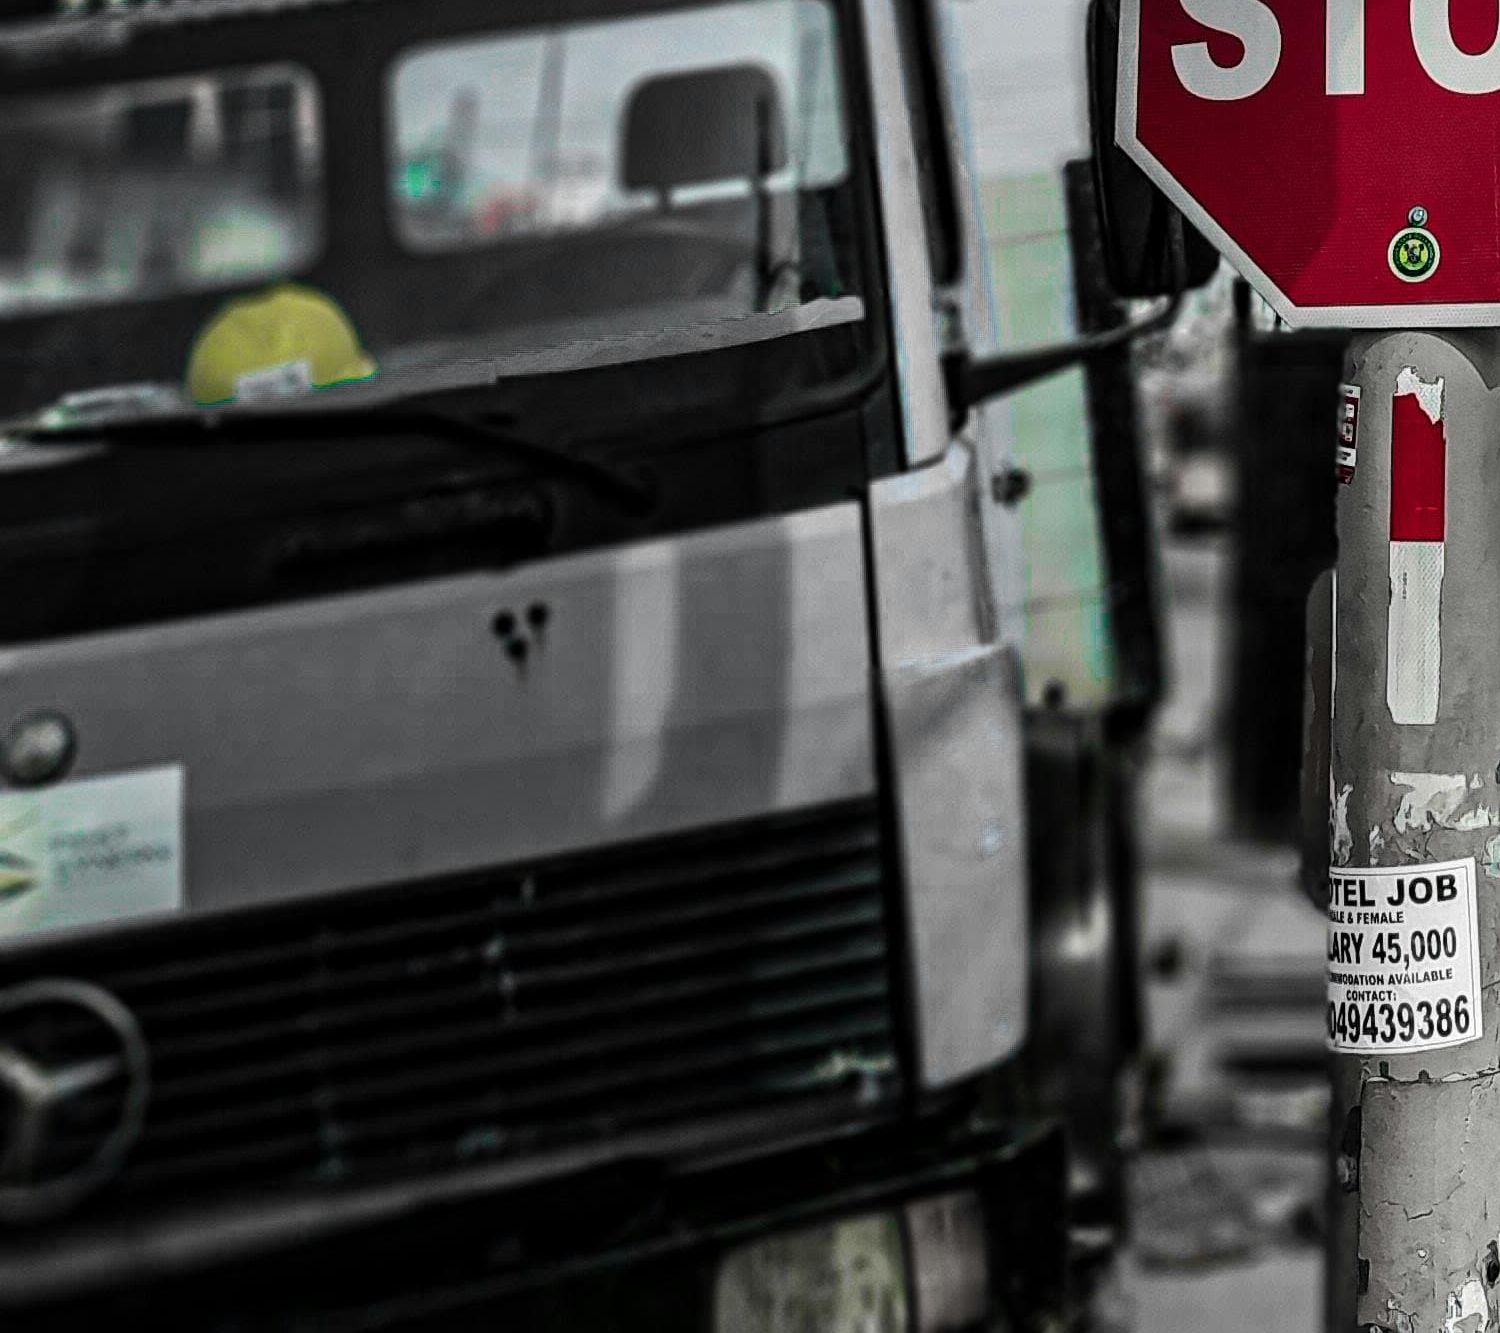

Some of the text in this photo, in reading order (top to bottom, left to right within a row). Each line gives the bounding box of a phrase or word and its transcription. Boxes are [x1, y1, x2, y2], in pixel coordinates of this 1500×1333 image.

[1387, 874, 1458, 907] JOB
[1347, 912, 1354, 924] &
[1356, 911, 1405, 925] FEMALE
[1372, 927, 1457, 970] 45,000
[1387, 968, 1453, 986] AVAILABLE
[1346, 990, 1397, 1002] CONTACT:
